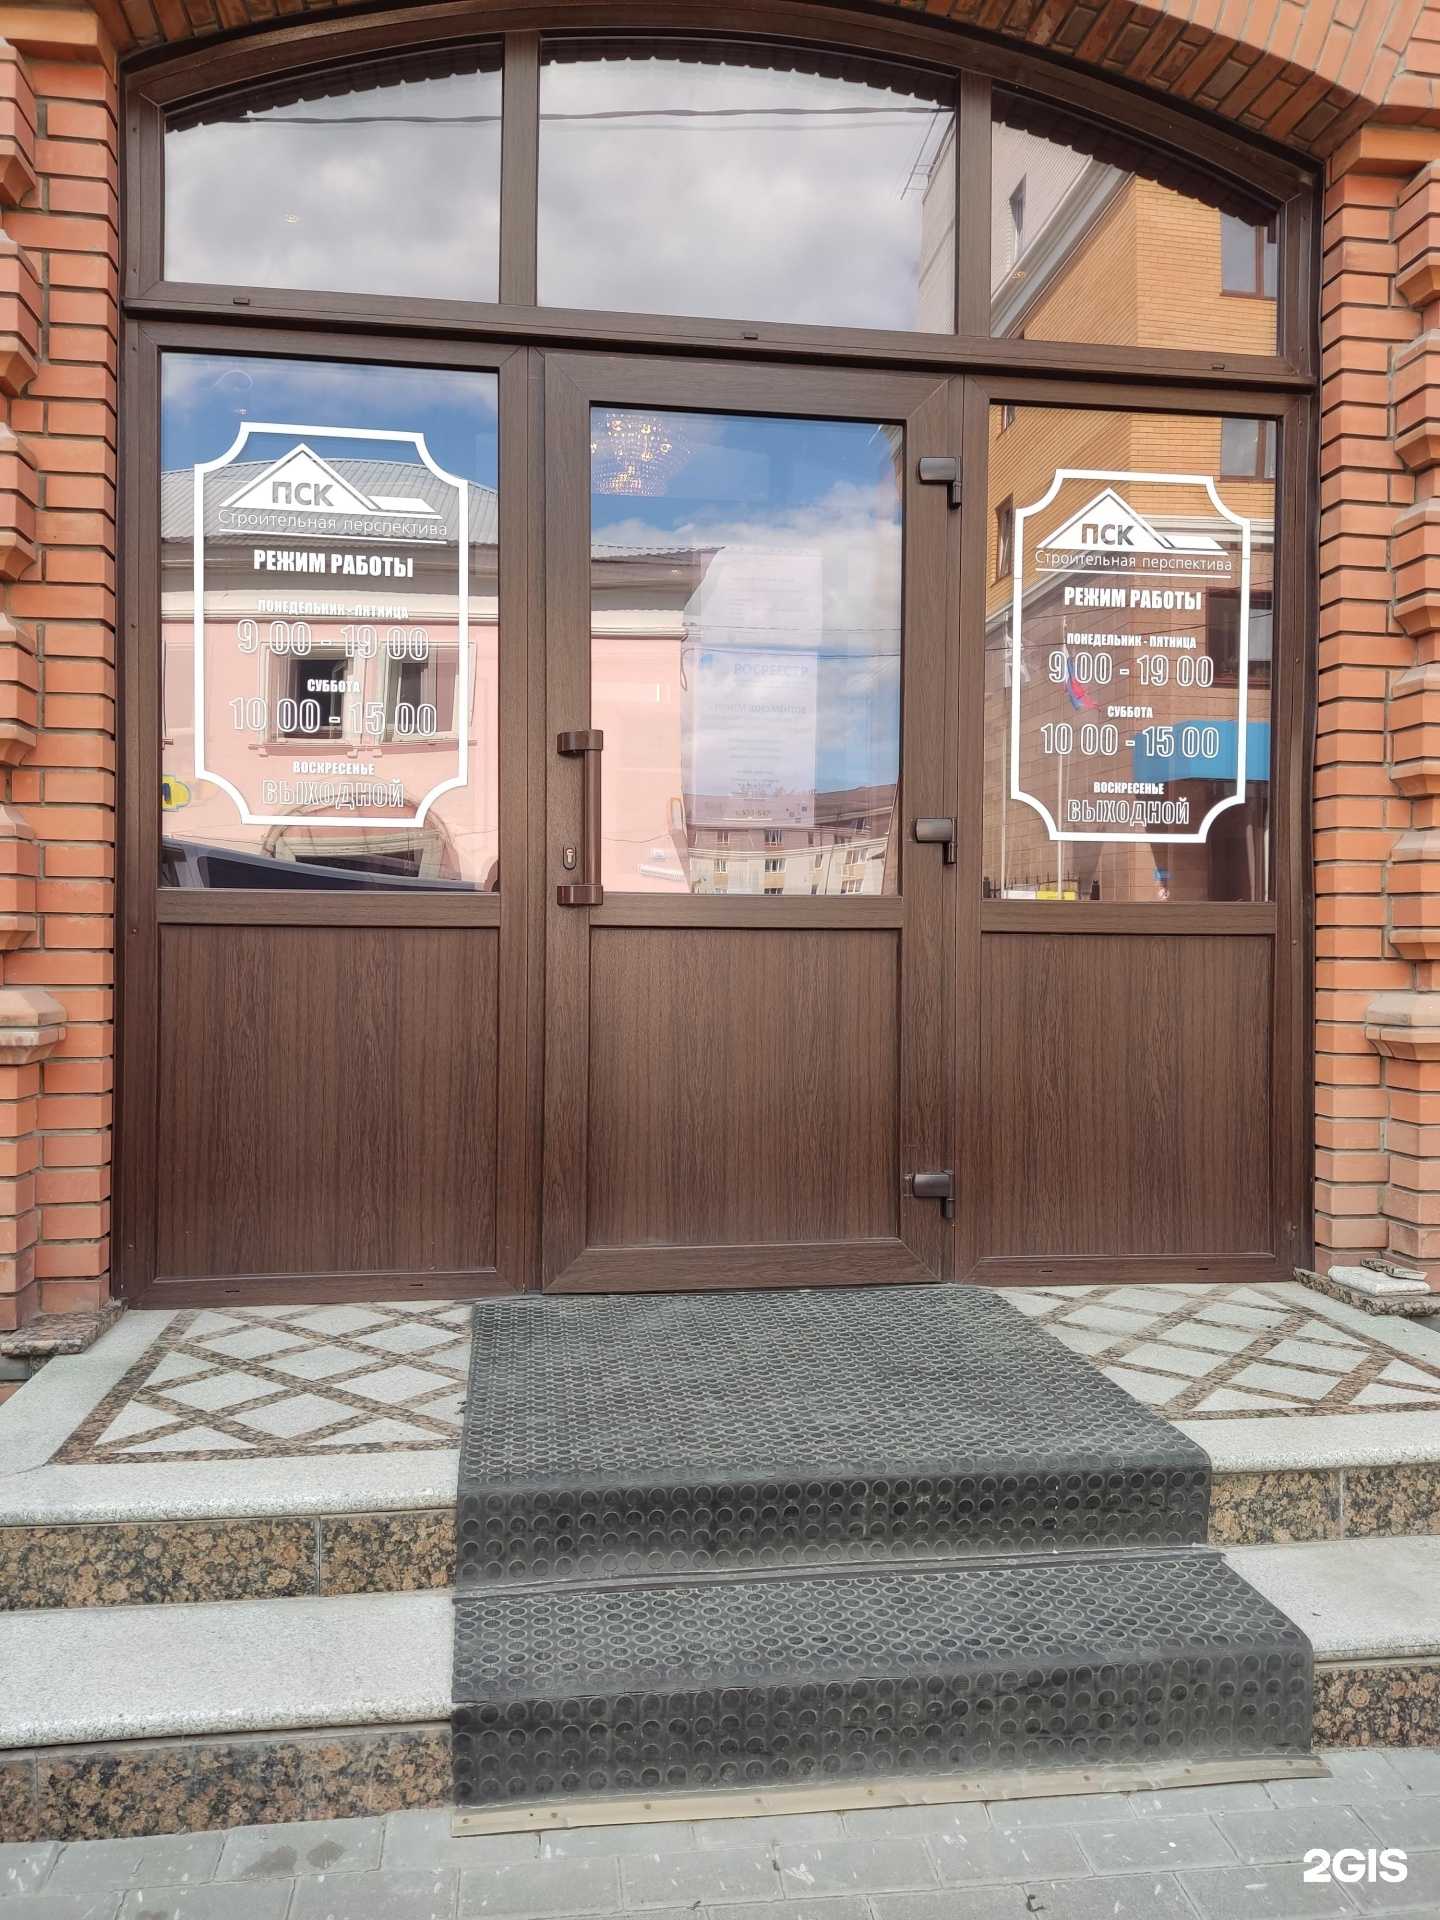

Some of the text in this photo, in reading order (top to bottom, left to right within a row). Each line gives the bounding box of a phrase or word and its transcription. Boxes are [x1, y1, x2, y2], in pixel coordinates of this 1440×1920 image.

[271, 481, 335, 507] ПСК
[217, 509, 447, 537] Строительная перспектива
[1081, 523, 1134, 546] ПСК
[254, 549, 414, 578] РЕЖИМ РАБОТЫ
[1035, 550, 1232, 571] Строительная перспектива
[257, 600, 345, 616] ПОНЕДЕЛЬНИК
[354, 605, 409, 619] ПЯТНИЦА
[1064, 587, 1201, 610] РЕЖИМ РАБОТЫ
[237, 619, 259, 653] 9
[341, 624, 377, 658] 19
[1067, 633, 1142, 647] ПОНЕДЕЛЬНИК
[1149, 636, 1196, 649] ПЯТНИЦА
[1049, 651, 1066, 683] 9
[1074, 652, 1113, 684] 00
[1137, 654, 1169, 686] 19
[1176, 655, 1214, 688] 00
[307, 678, 360, 693] СУББОТА
[229, 697, 268, 731] 10
[350, 702, 385, 735] 15
[1107, 705, 1153, 718] СУББОТА
[1040, 723, 1073, 755] 10
[1080, 723, 1118, 756] 00
[1142, 726, 1175, 758] 15
[1182, 727, 1219, 758] 00
[293, 761, 375, 775] ВОСКРЕСЕНЬЕ
[263, 778, 404, 810] ВЫХОДНОЙ
[1094, 782, 1164, 795] ВОСКРЕСЕНЬЕ
[1067, 797, 1189, 827] ВЫХОДНОЙ
